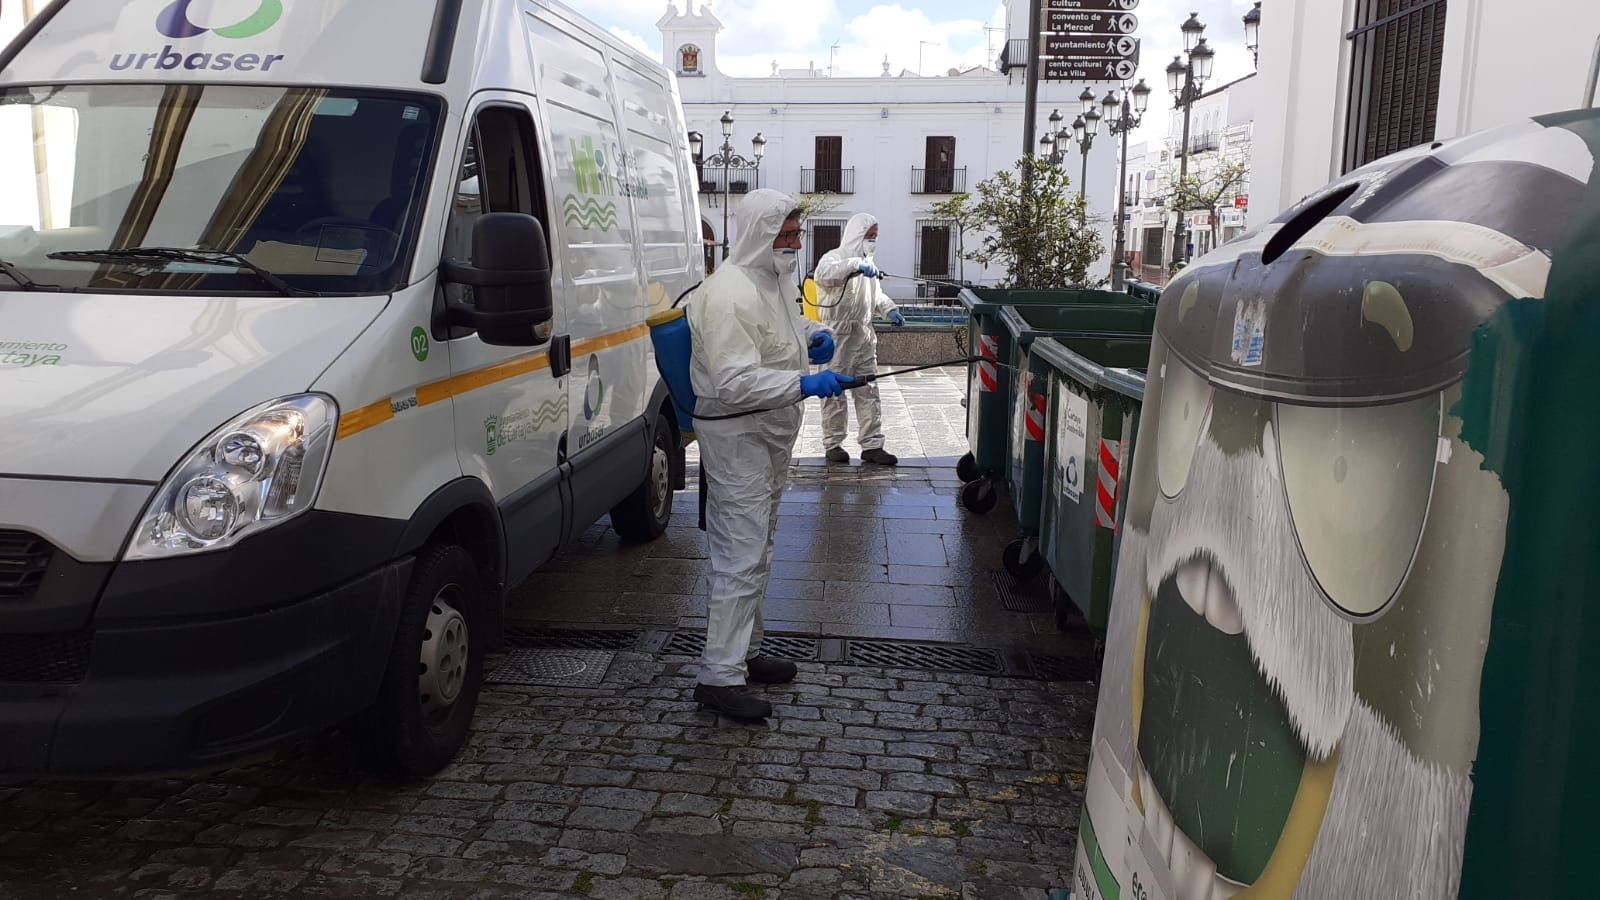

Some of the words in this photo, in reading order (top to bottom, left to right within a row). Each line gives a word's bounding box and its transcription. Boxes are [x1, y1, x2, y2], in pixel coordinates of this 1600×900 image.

[1052, 13, 1089, 21] convento
[1091, 13, 1101, 21] de
[1051, 23, 1061, 31] La
[1049, 41, 1106, 50] ayuntamiento
[109, 45, 285, 72] urbaser
[412, 334, 428, 354] 02
[578, 424, 604, 449] urbaser
